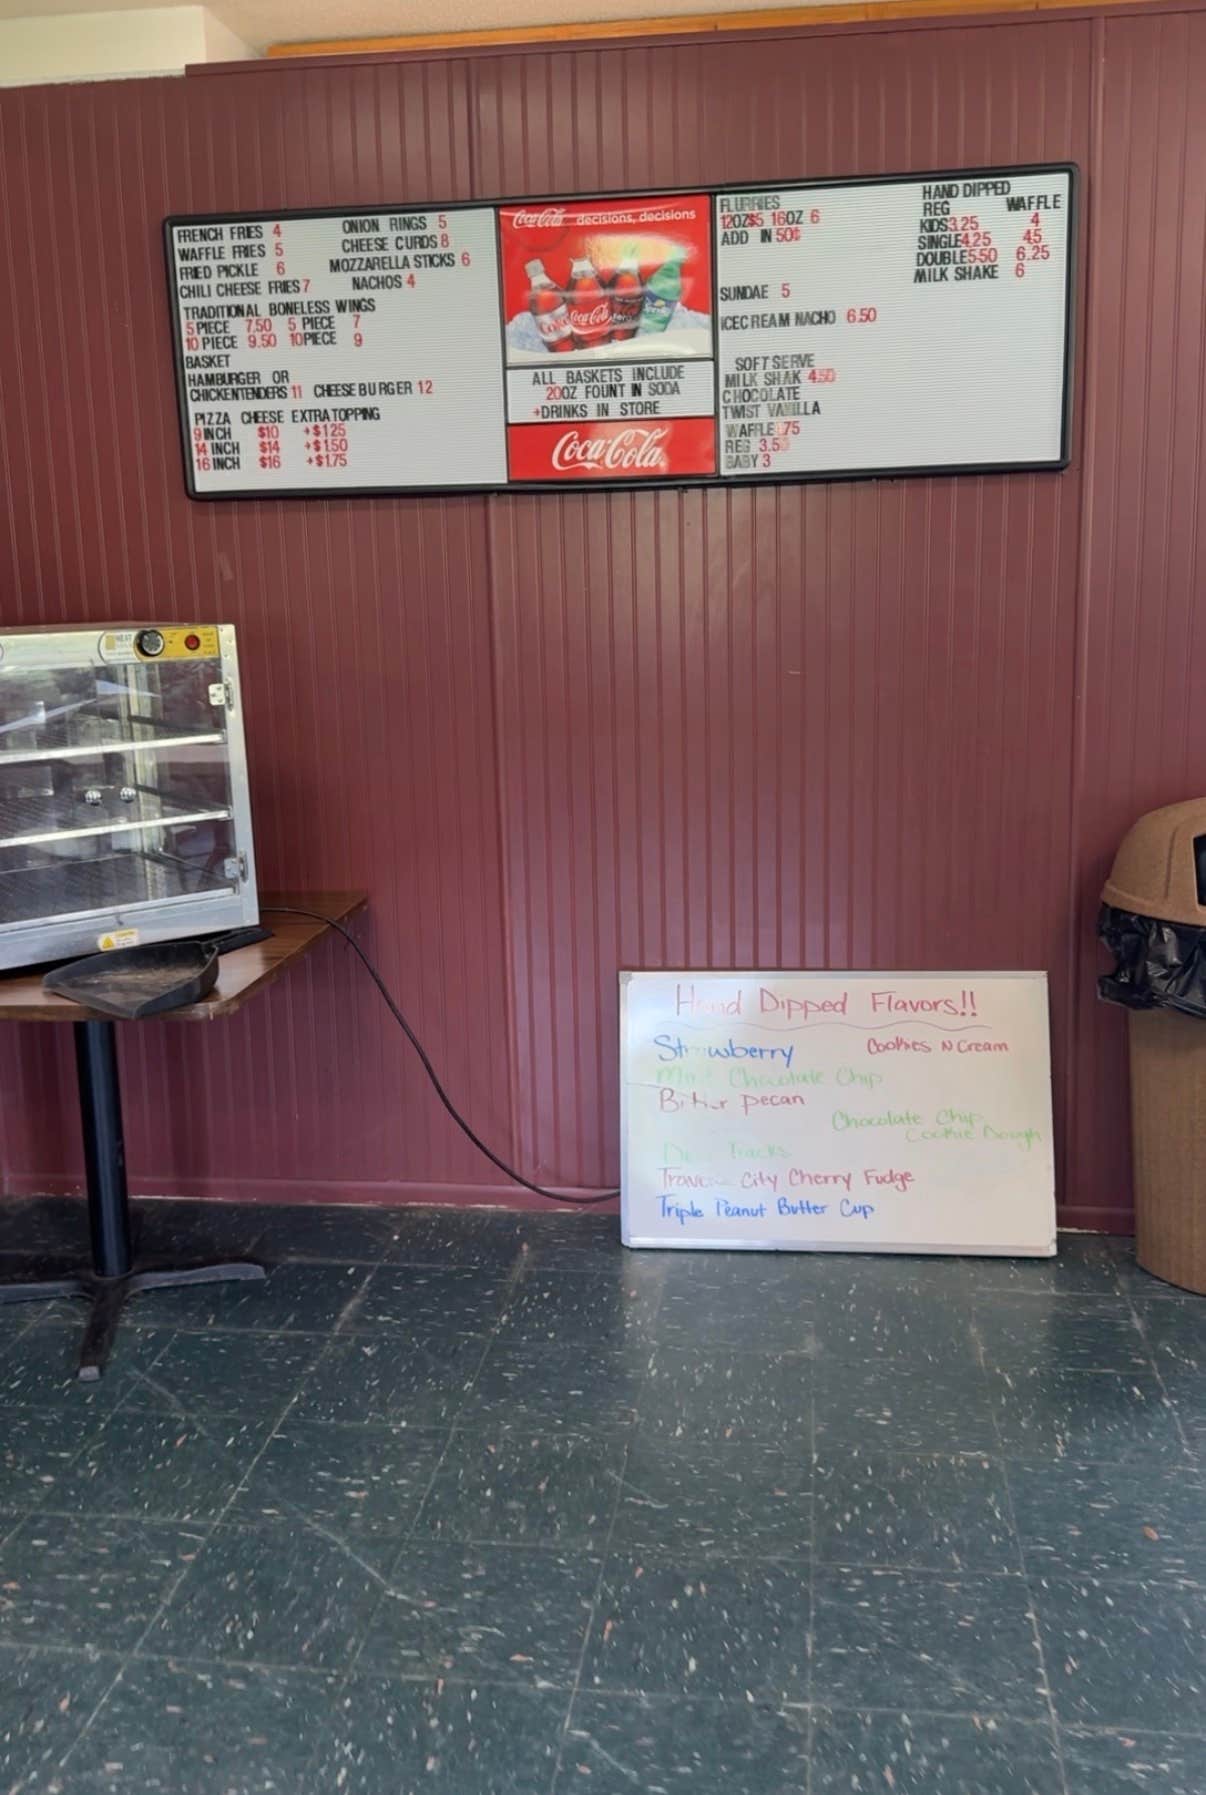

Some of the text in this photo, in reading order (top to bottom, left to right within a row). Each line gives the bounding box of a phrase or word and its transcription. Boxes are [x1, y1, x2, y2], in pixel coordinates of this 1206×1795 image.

[923, 181, 1011, 200] HAND DIPPED
[923, 194, 1062, 216] REG WAFFLE
[342, 215, 447, 234] ONION RINGS 5
[577, 213, 636, 225] decisions,
[640, 210, 696, 222] decisions
[810, 209, 820, 224] 6
[1031, 212, 1040, 227] 4
[178, 224, 281, 243] FRENCH FRIES 4
[721, 230, 748, 245] ADD
[761, 229, 772, 243] IN
[342, 234, 448, 253] CHEESE CURDS 8
[178, 244, 283, 262] WAFFLE FRIES 5
[1016, 245, 1050, 261] 6.25
[180, 262, 285, 280] FRIED PICKLE 6
[330, 253, 470, 273] MOZZARELLA STICKS 6
[352, 274, 416, 290] NACHOS 4
[914, 263, 1024, 283] MILK SHAKE 6
[180, 279, 310, 299] CHILI CHEESE FRIES 7
[720, 283, 790, 301] SUNDAE 5
[184, 298, 375, 319] TRADITIONAL BONELESS WINGS
[795, 310, 836, 327] NACHO
[847, 307, 876, 323] 6.50
[197, 320, 230, 334] PIECE
[246, 318, 272, 332] 7.50
[288, 317, 296, 331] 5
[302, 316, 335, 330] PIECE
[353, 315, 360, 329] 7
[186, 337, 198, 350] 10
[202, 335, 238, 349] PIECE
[248, 333, 277, 348] 9.50
[354, 333, 362, 347] 9
[185, 355, 231, 369] BASKET
[736, 353, 815, 371] SOFT SERVE
[188, 370, 289, 386] HAMBURGER OR
[533, 366, 684, 385] ALL BASKETS INCLUDE
[725, 373, 757, 388] MILK
[764, 371, 801, 386] SHAK
[292, 385, 302, 398] 11
[417, 380, 433, 394] 12
[585, 383, 625, 398] FOUNT
[631, 383, 641, 397] IN
[649, 381, 680, 396] SODA
[723, 386, 800, 403] CHOCOLATE
[195, 406, 380, 425] PIZZA CHEESE EXTRA TOPPING
[597, 403, 608, 416] IN
[621, 401, 660, 415] STORE
[722, 404, 761, 420] TWIST
[194, 428, 201, 441] 9
[203, 426, 232, 440] INCH
[258, 425, 279, 439] $10
[726, 422, 774, 438] WAFFLE
[195, 443, 207, 456] 14
[211, 441, 240, 455] INCH
[259, 440, 280, 454] $14
[725, 439, 750, 453] REG
[196, 458, 210, 471] 16
[213, 456, 240, 470] INCH
[259, 455, 280, 469] $16
[726, 454, 771, 469] BABY 3
[760, 987, 848, 1020] Dipped
[871, 990, 978, 1017] Flavors!!
[957, 1040, 1008, 1053] Cream
[741, 1093, 805, 1115] pecan
[832, 1110, 921, 1131] Chocolate
[741, 1172, 778, 1192] City
[788, 1168, 852, 1191] Cherry
[864, 1169, 916, 1192] Fudge
[656, 1194, 874, 1225] Triple Peanut Butter Cup
